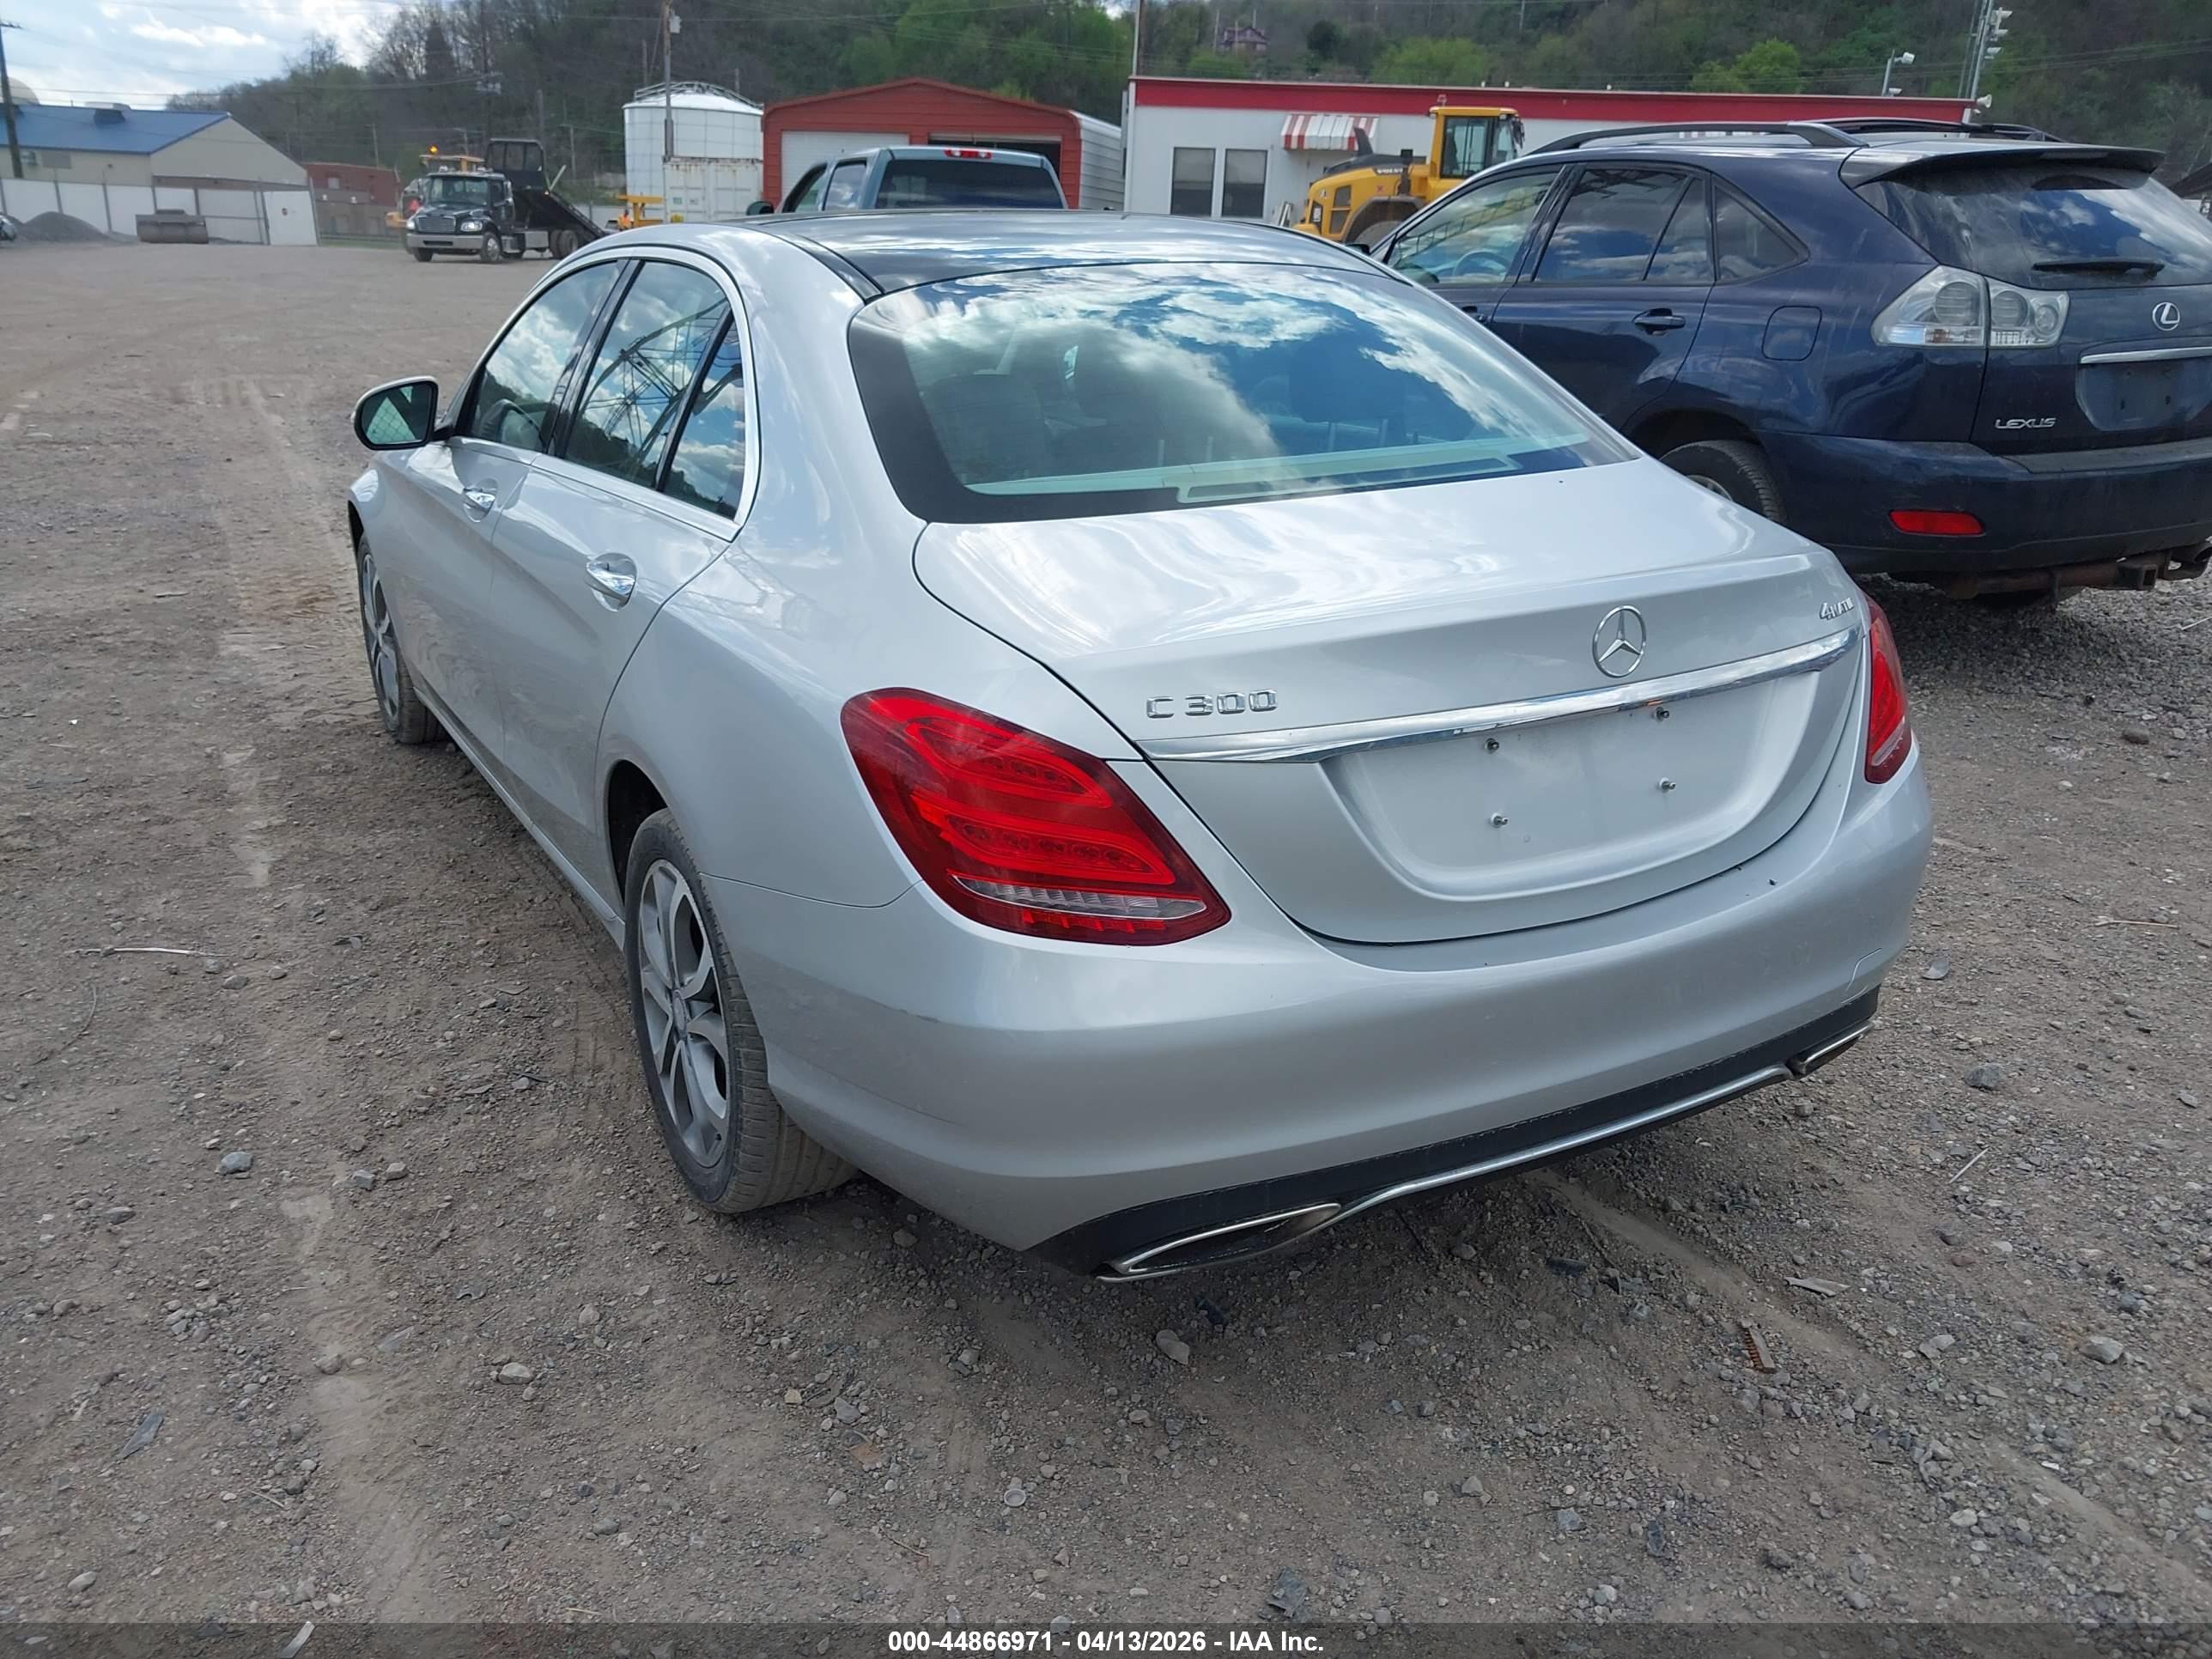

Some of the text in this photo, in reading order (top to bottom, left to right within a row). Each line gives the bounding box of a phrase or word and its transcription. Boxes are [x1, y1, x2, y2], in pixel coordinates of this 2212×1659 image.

[1994, 417, 2057, 429] LEXUS
[1146, 689, 1278, 719] C 300
